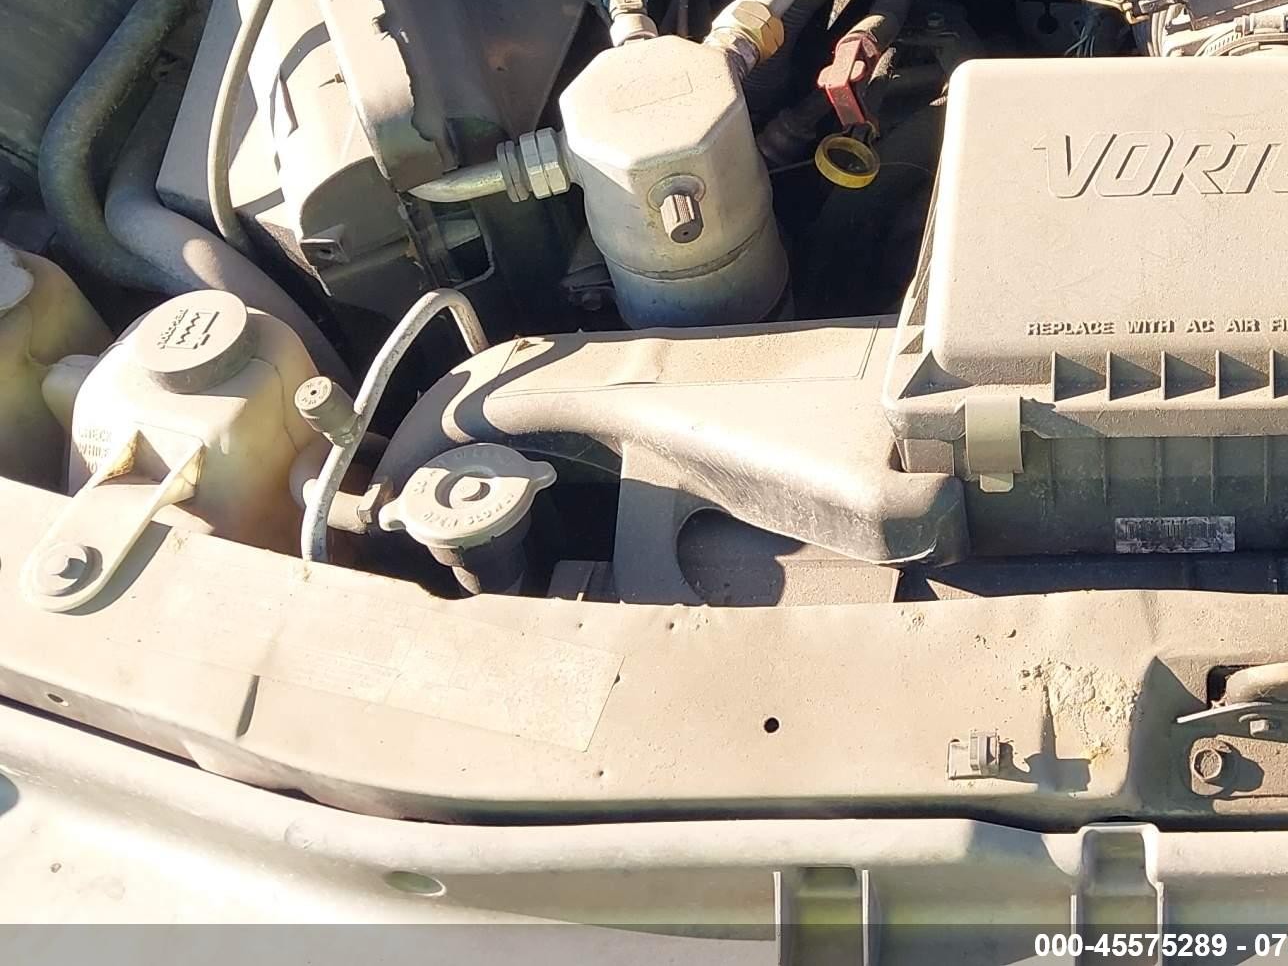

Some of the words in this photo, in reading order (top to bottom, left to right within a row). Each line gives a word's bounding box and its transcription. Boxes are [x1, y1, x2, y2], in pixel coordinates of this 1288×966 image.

[1027, 320, 1115, 336] REPLACE
[1127, 320, 1175, 335] WITH
[1186, 319, 1215, 333] AC
[1226, 318, 1260, 333] AIR
